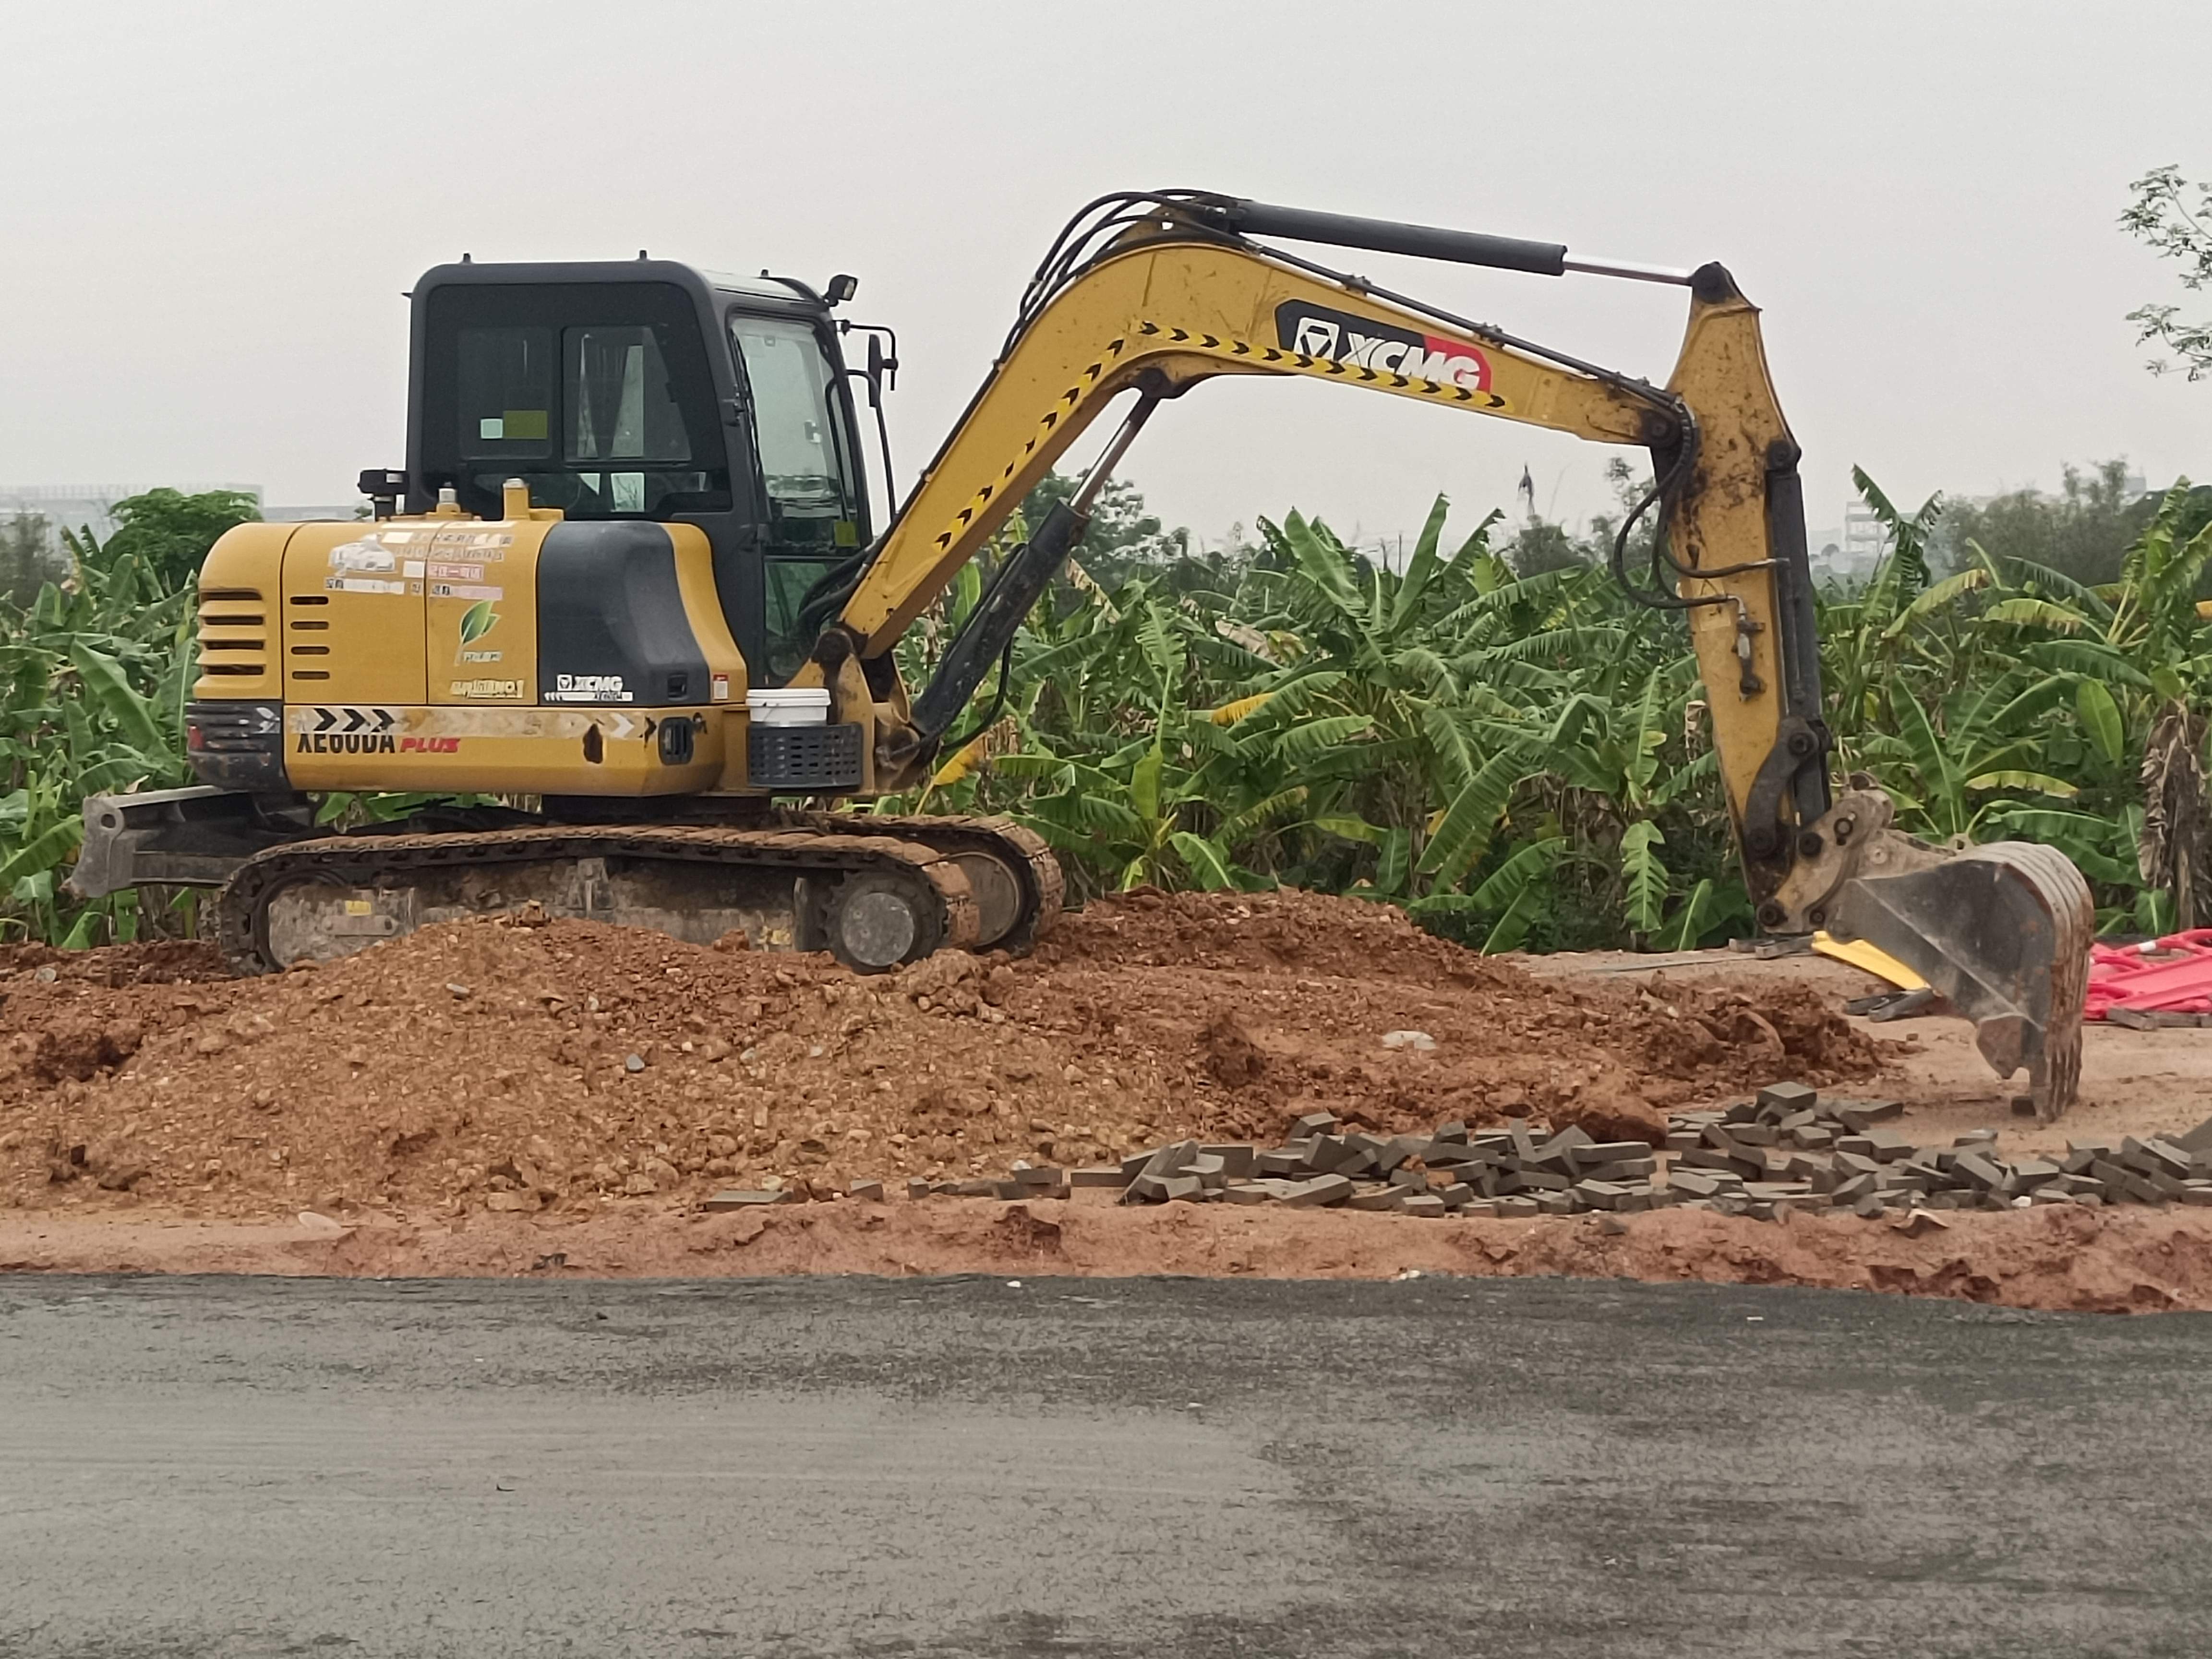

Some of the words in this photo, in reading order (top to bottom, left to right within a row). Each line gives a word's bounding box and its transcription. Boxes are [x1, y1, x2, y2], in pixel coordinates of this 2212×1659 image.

[1339, 331, 1480, 390] XCMG
[572, 676, 623, 692] XCMG
[399, 737, 461, 753] PLUS
